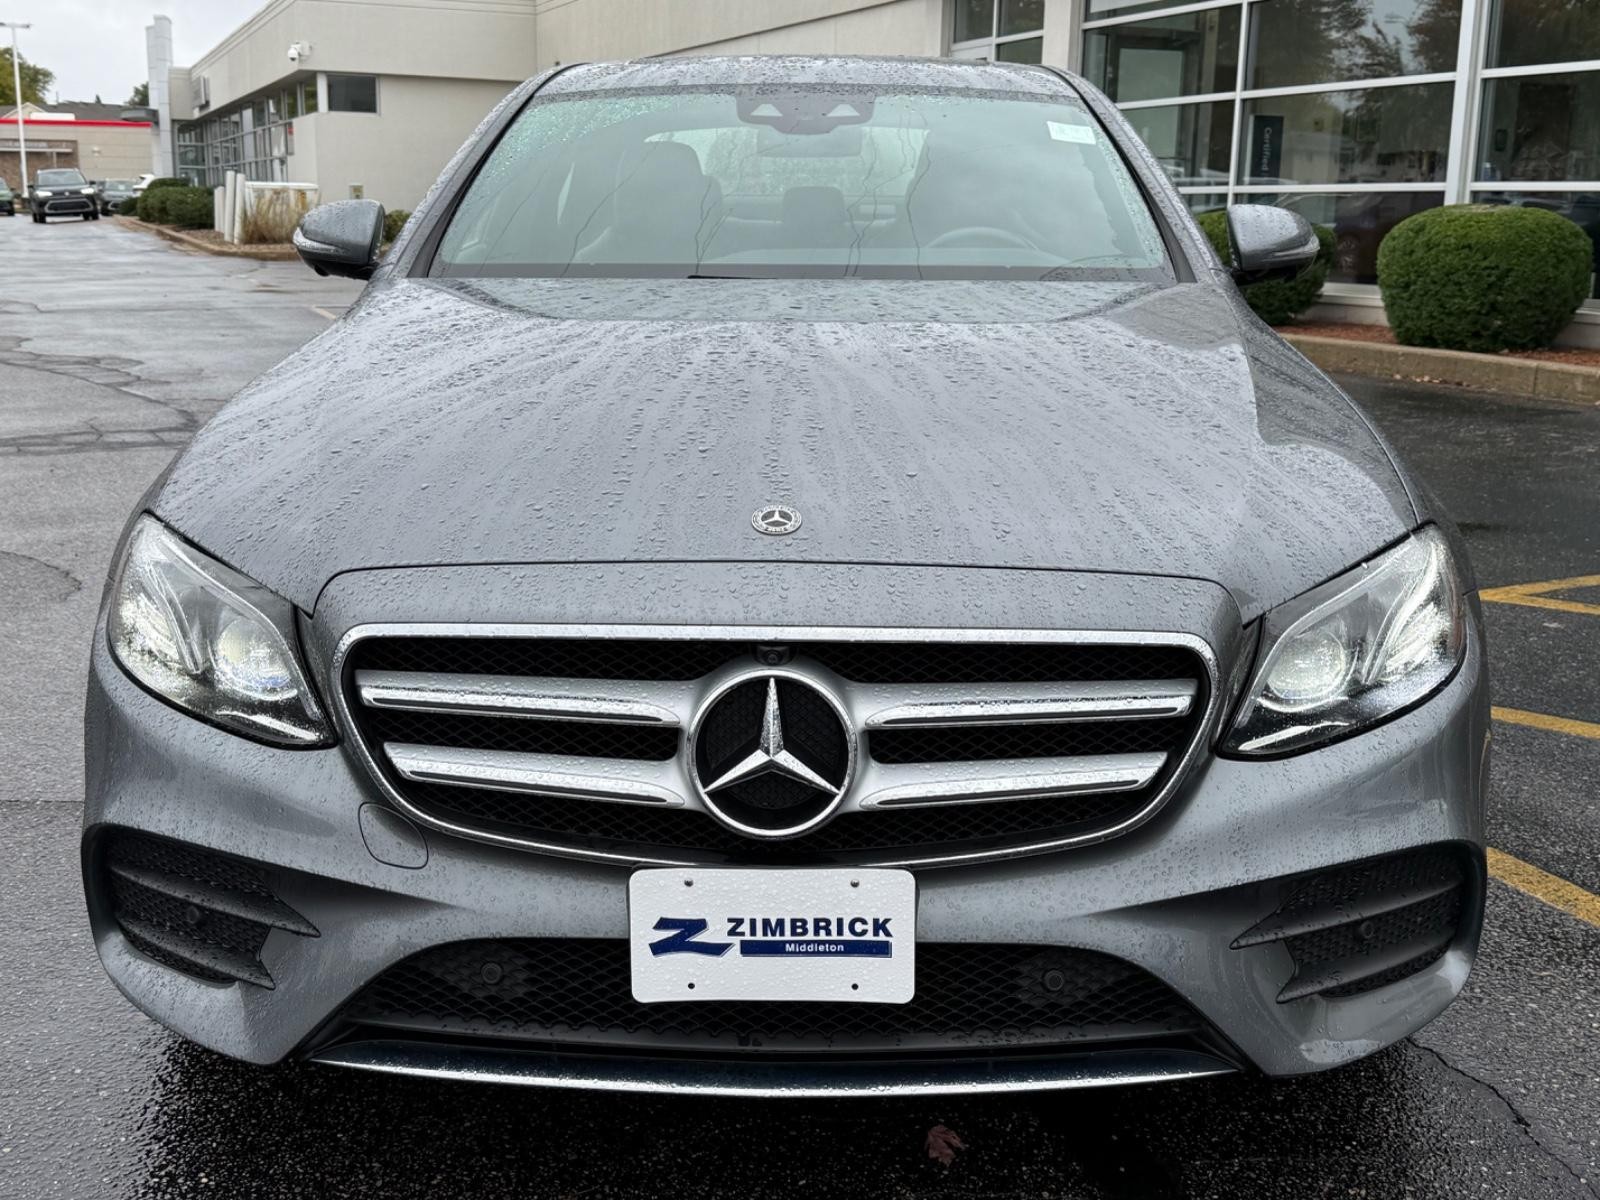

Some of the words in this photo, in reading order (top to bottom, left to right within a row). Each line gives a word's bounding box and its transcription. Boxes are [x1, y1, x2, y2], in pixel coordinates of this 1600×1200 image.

[1261, 127, 1272, 170] Certified
[727, 917, 893, 937] ZIMBRICK
[785, 941, 845, 953] Middleton
